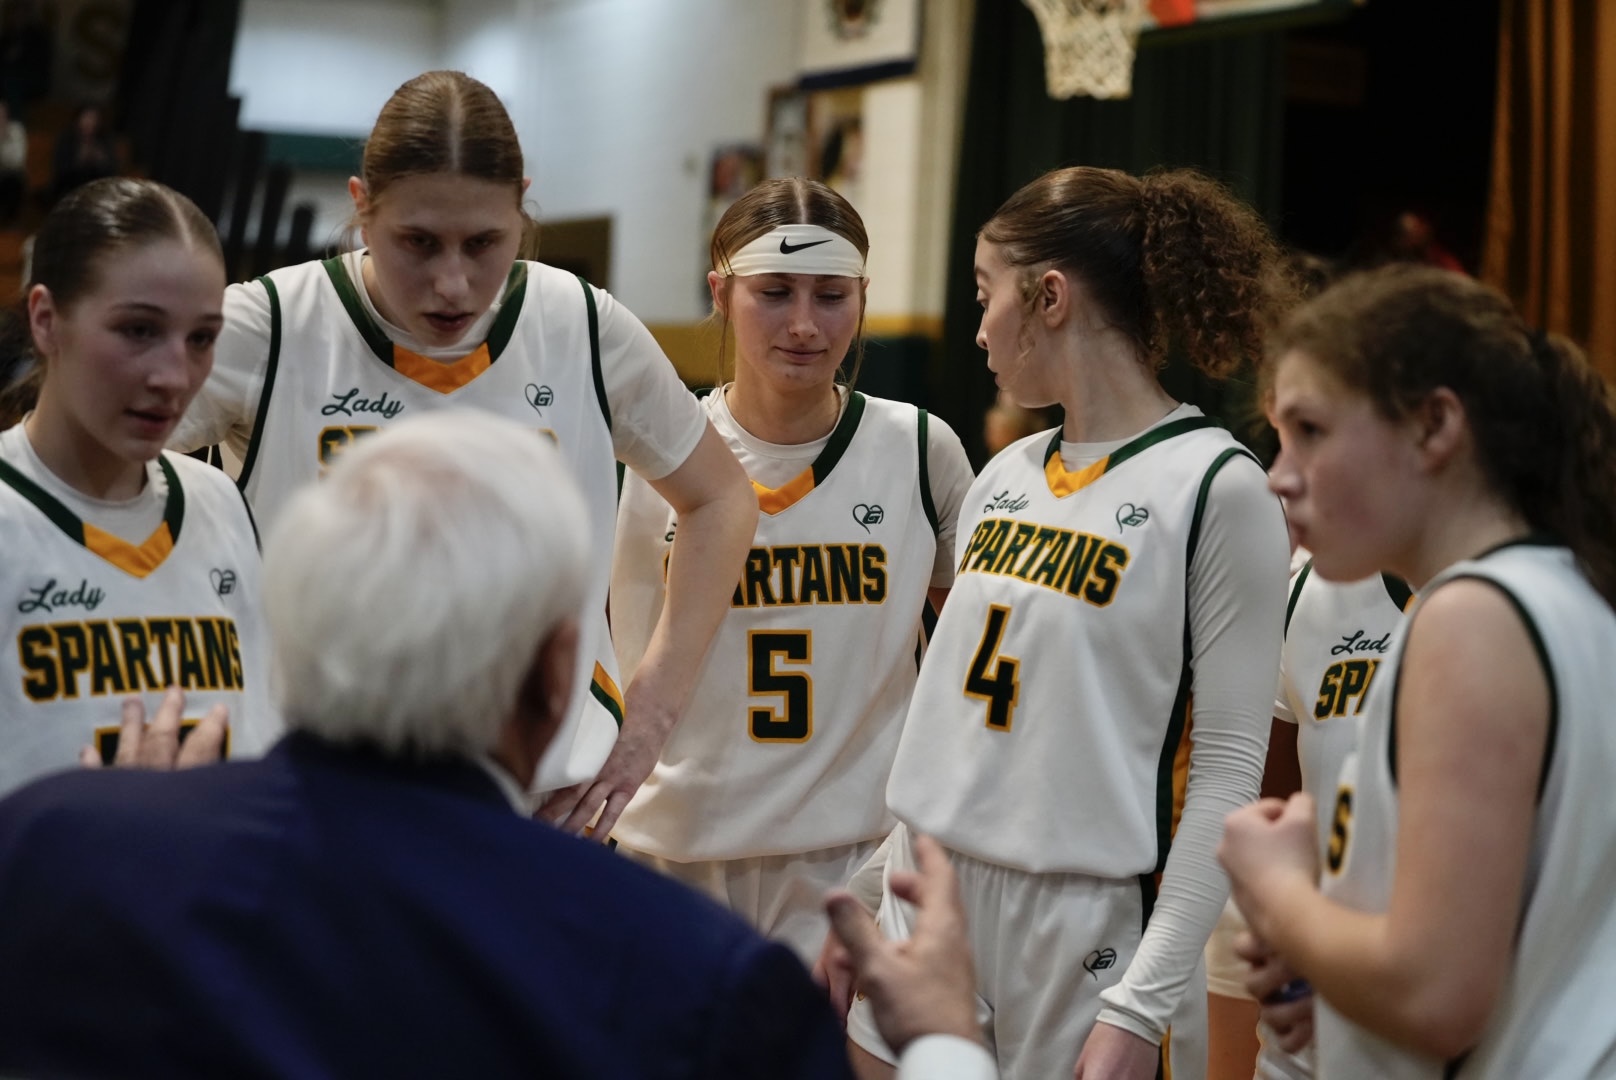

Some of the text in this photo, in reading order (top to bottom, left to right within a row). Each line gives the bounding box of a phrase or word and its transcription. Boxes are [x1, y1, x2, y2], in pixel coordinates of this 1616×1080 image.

[321, 388, 405, 419] Lady
[983, 490, 1030, 513] Lady
[17, 578, 106, 613] Lady
[17, 616, 244, 704] SPARTANS
[747, 629, 813, 743] 5
[963, 603, 1021, 733] 4
